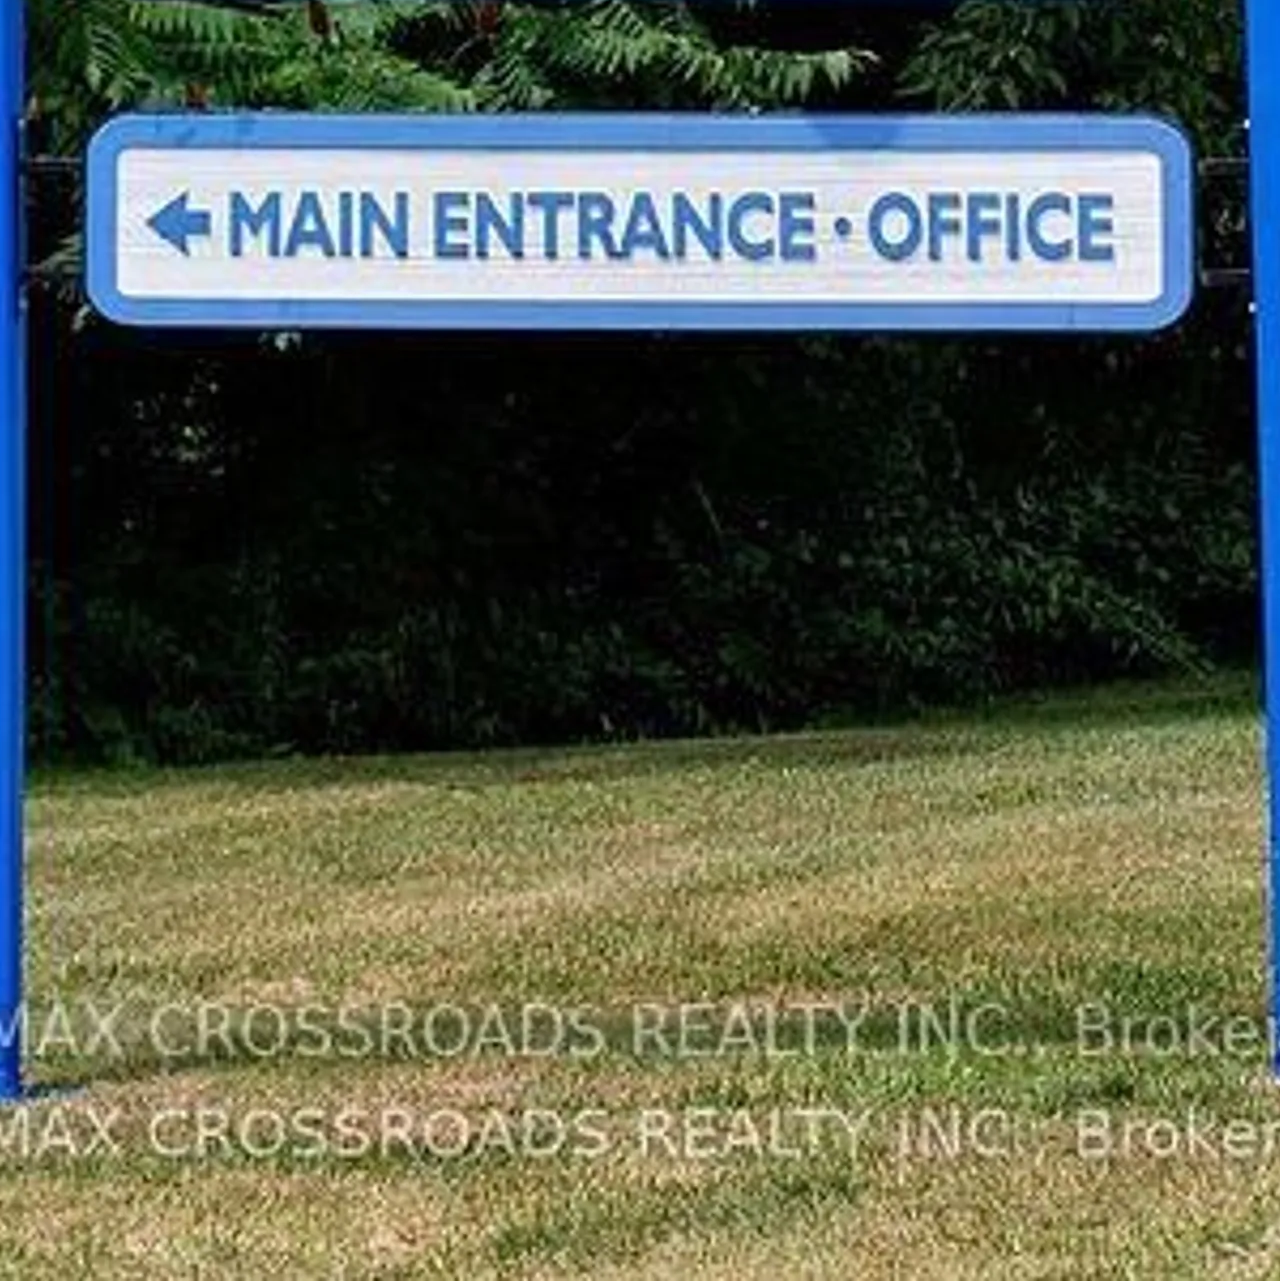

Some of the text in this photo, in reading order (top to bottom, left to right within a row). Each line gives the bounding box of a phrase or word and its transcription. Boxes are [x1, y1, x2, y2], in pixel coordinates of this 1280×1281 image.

[228, 191, 1115, 264] MAIN ENTRANCE OFFICE
